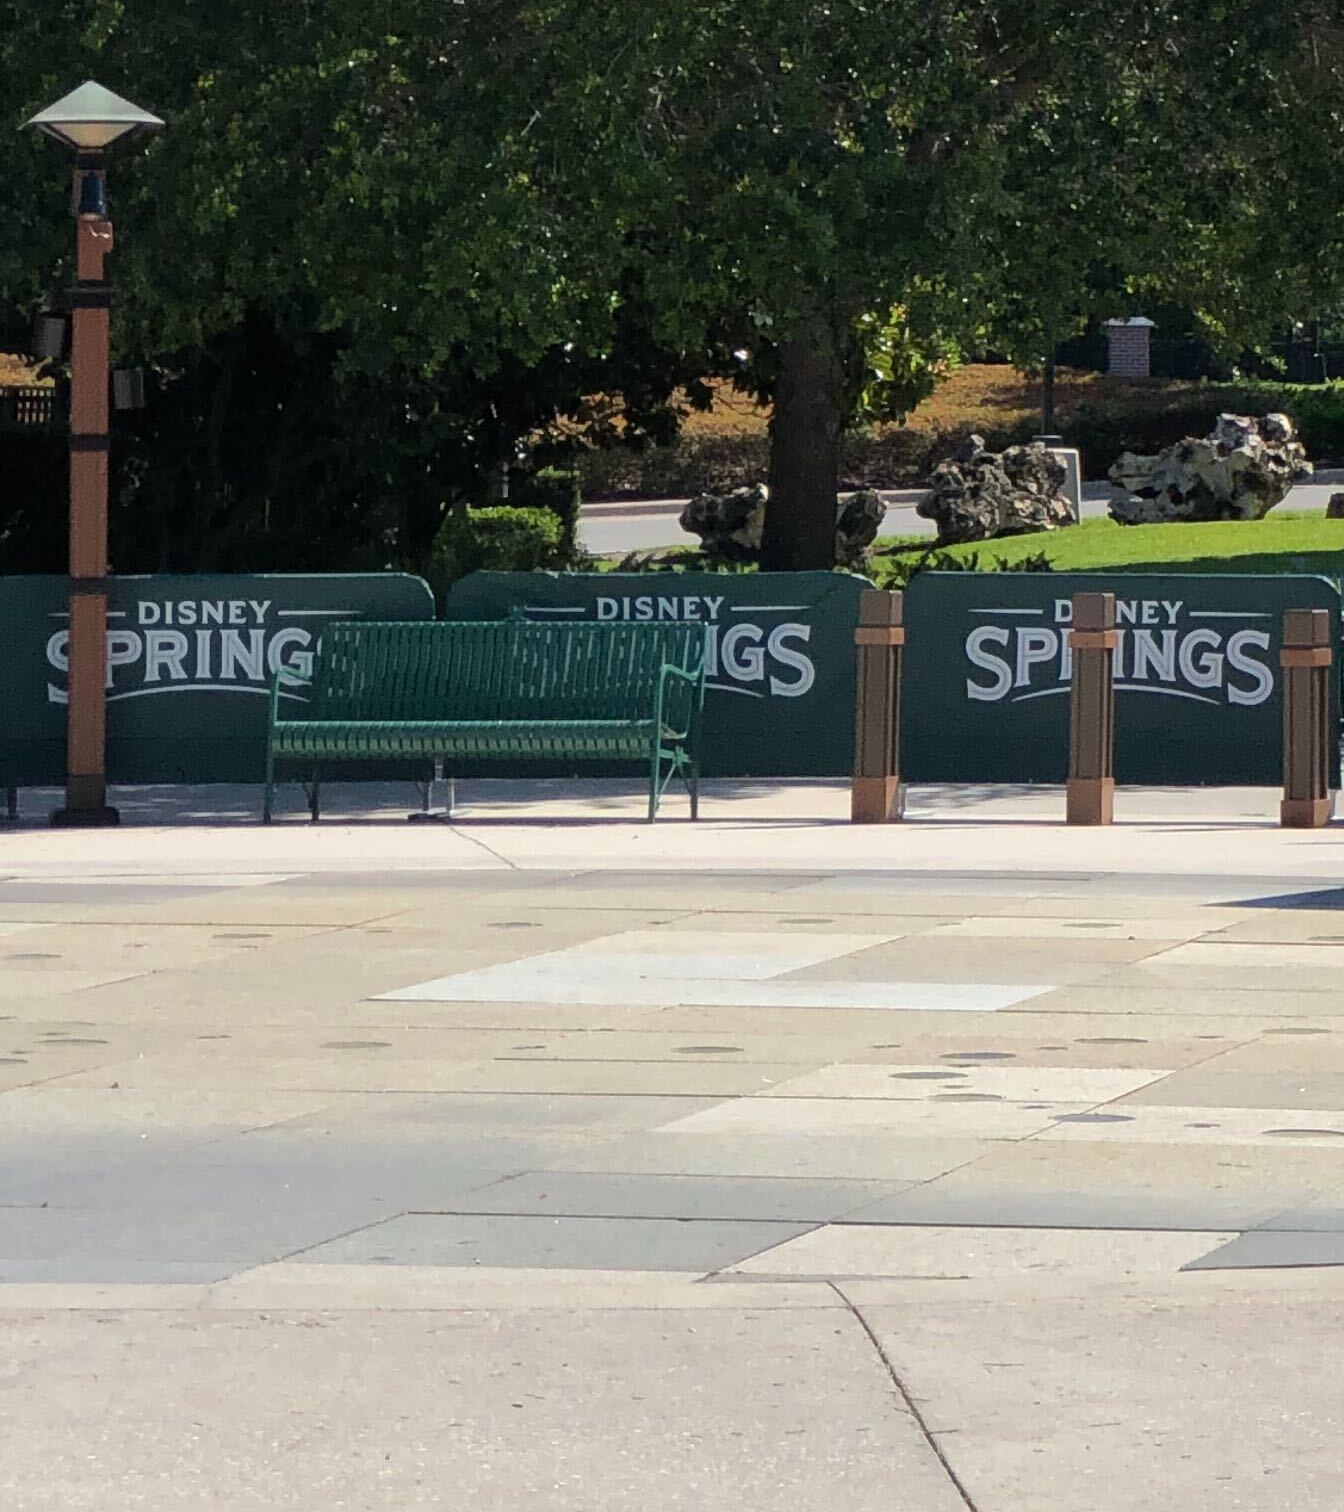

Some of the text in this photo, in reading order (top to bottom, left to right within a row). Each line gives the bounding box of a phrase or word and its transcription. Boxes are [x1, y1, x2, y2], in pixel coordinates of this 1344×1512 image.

[138, 600, 272, 625] DISNEY
[596, 596, 725, 621] DISNEY
[1054, 599, 1184, 625] DNEY
